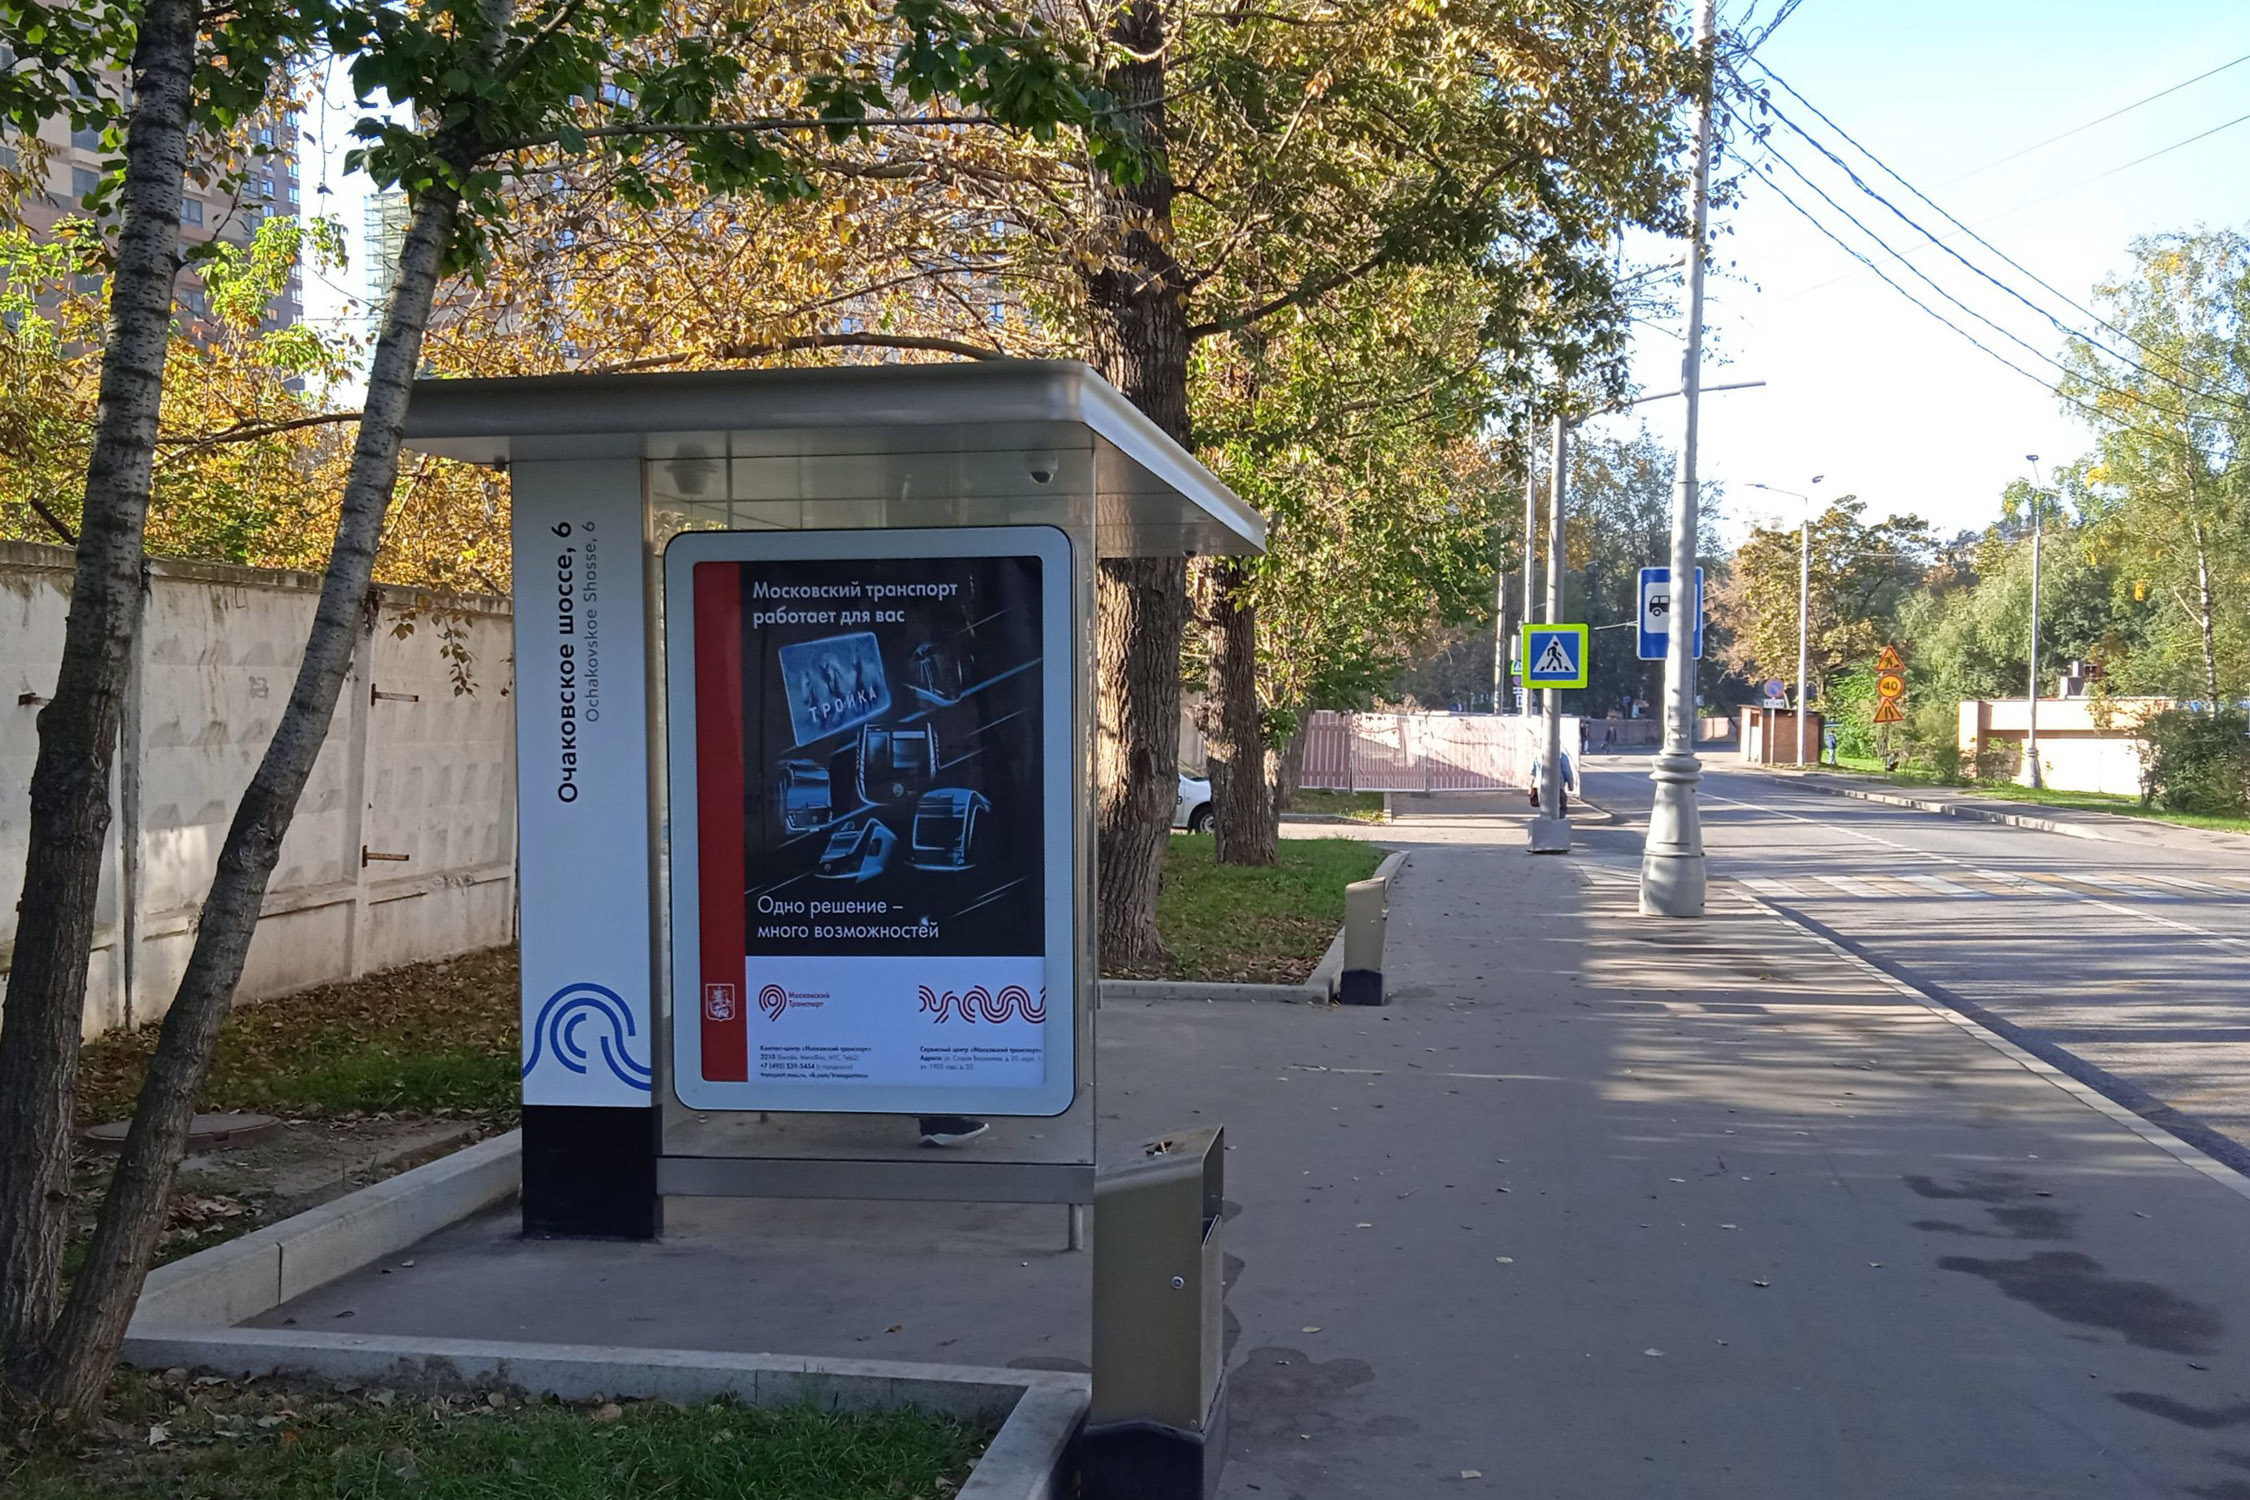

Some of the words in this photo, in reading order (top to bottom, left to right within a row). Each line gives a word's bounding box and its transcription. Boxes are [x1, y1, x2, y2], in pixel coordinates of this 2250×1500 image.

[551, 521, 572, 538] 6
[581, 520, 596, 532] 6
[582, 538, 600, 602] Shosse,
[557, 547, 577, 635] шоссе,
[752, 580, 862, 599] Московский
[865, 582, 958, 601] транспорт
[752, 606, 836, 629] работает
[839, 608, 871, 626] для
[875, 608, 905, 623] вас
[584, 608, 600, 722] Ochakovskoe
[1882, 681, 1898, 691] 40
[808, 686, 877, 723] ТРОЙКА
[558, 644, 578, 803] Очаковское
[756, 894, 806, 917] Одно
[810, 900, 888, 919] решение
[756, 924, 809, 939] много
[813, 921, 940, 939] возможностей
